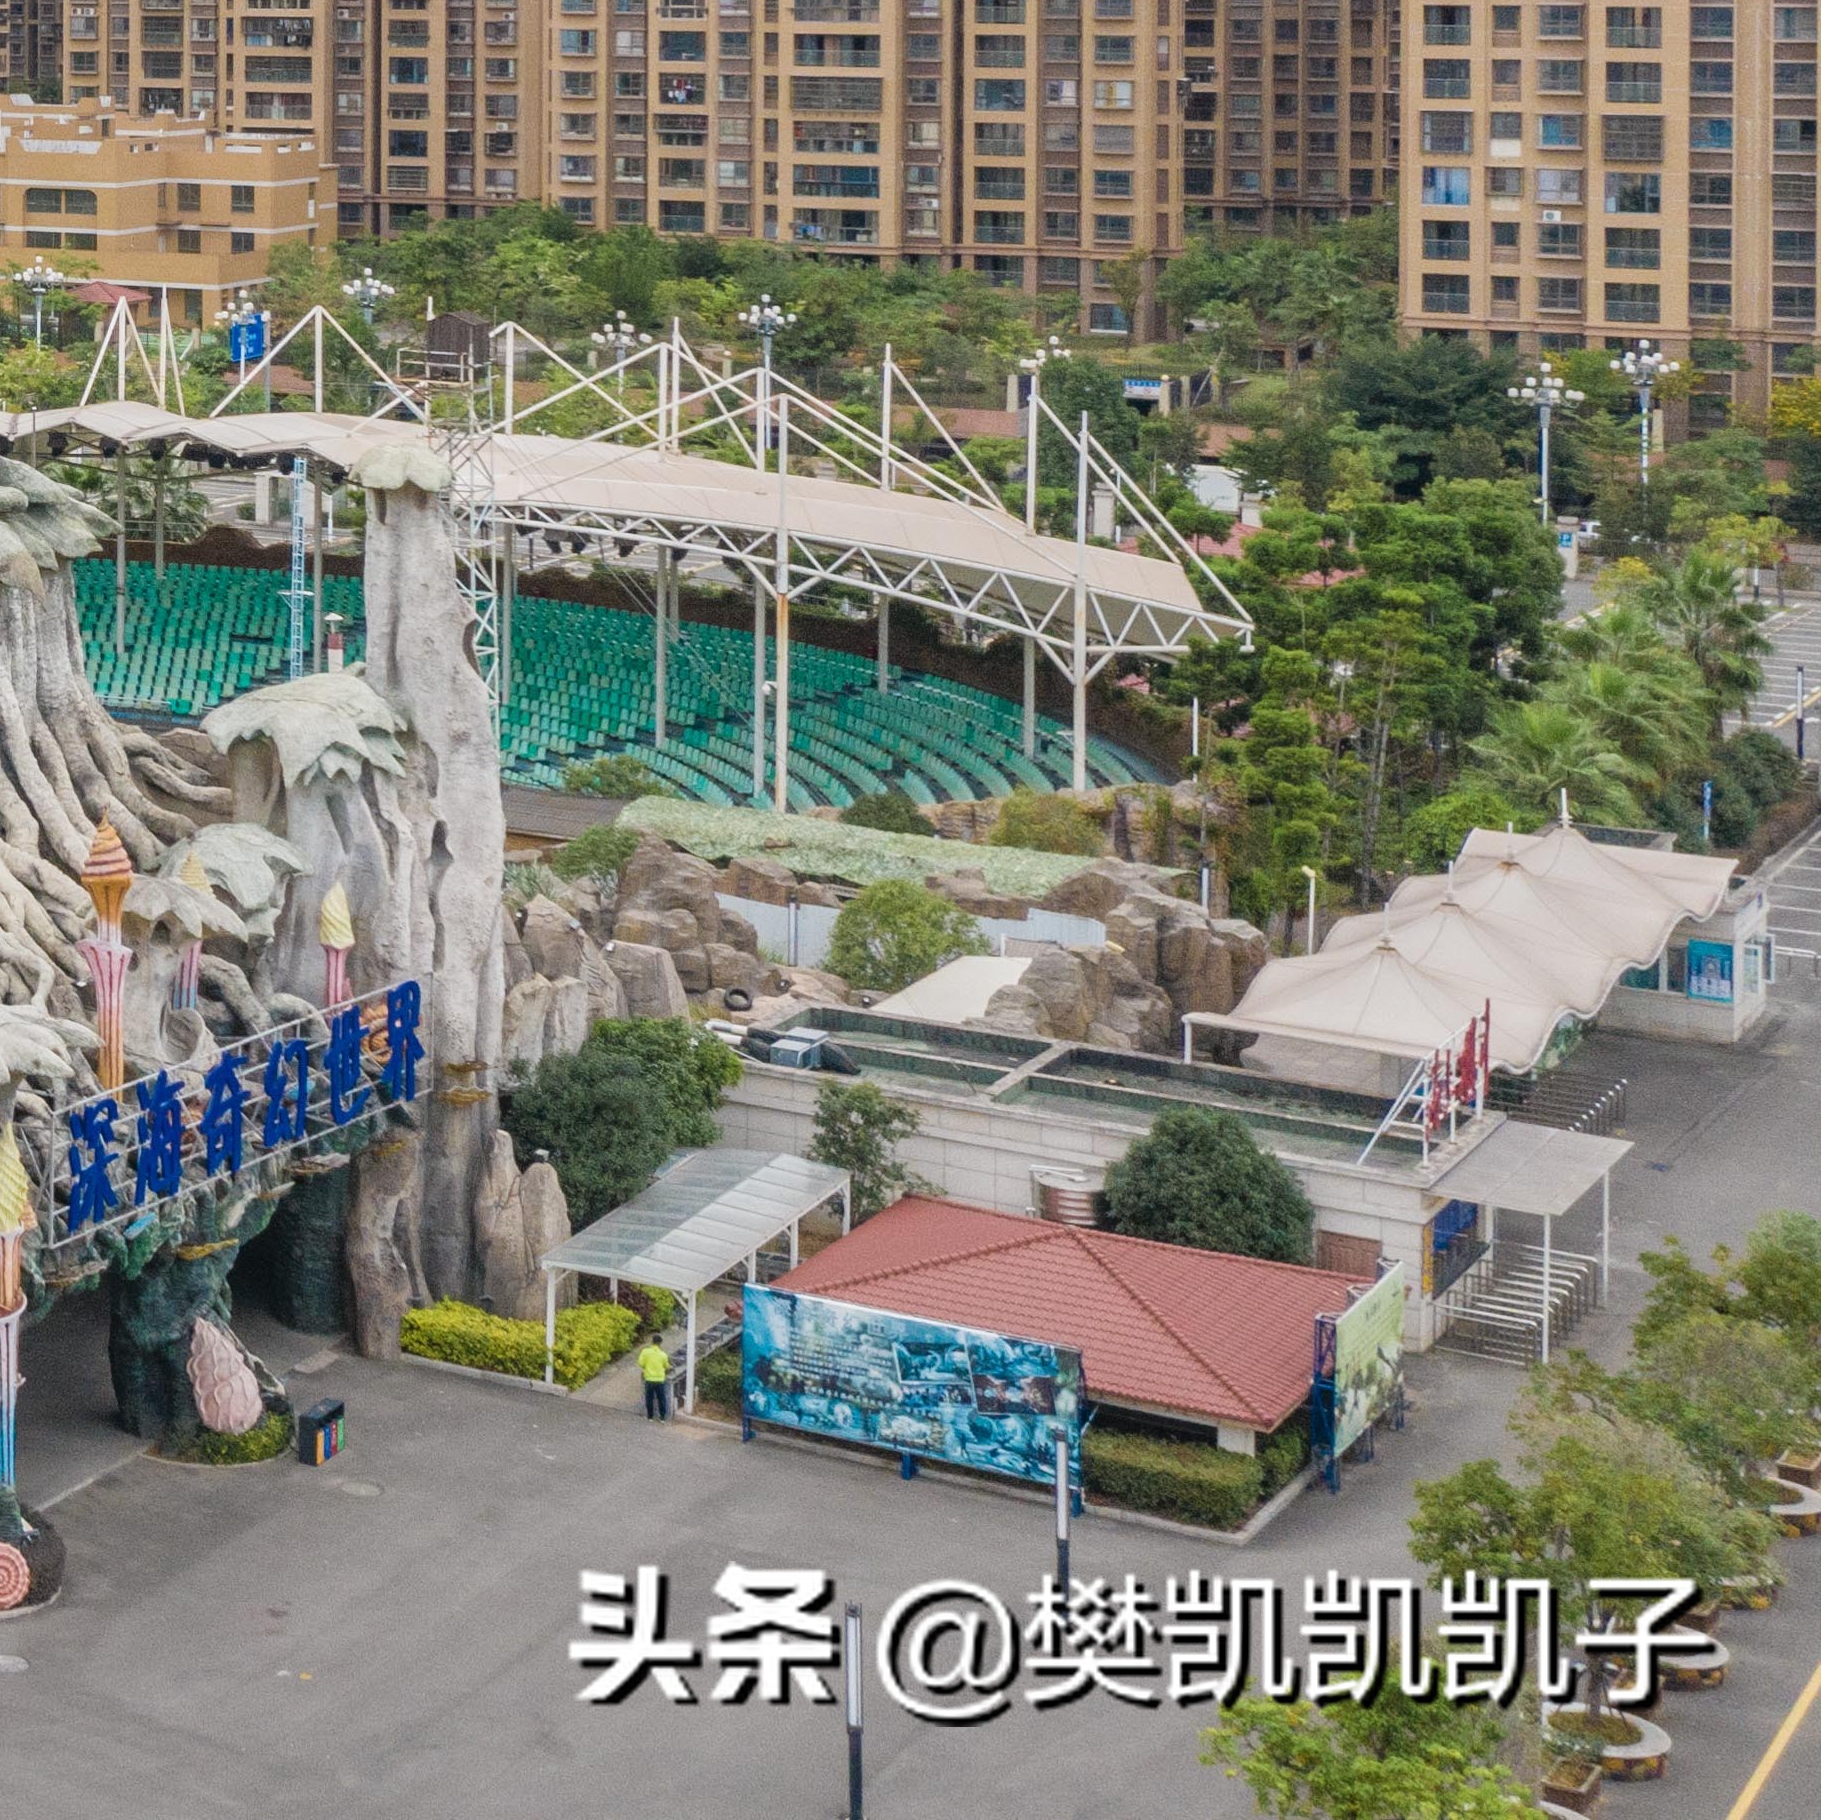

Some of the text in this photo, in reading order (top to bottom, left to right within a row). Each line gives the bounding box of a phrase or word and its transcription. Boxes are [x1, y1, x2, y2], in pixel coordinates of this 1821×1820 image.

[67, 980, 426, 1233] 深海奇幻世界
